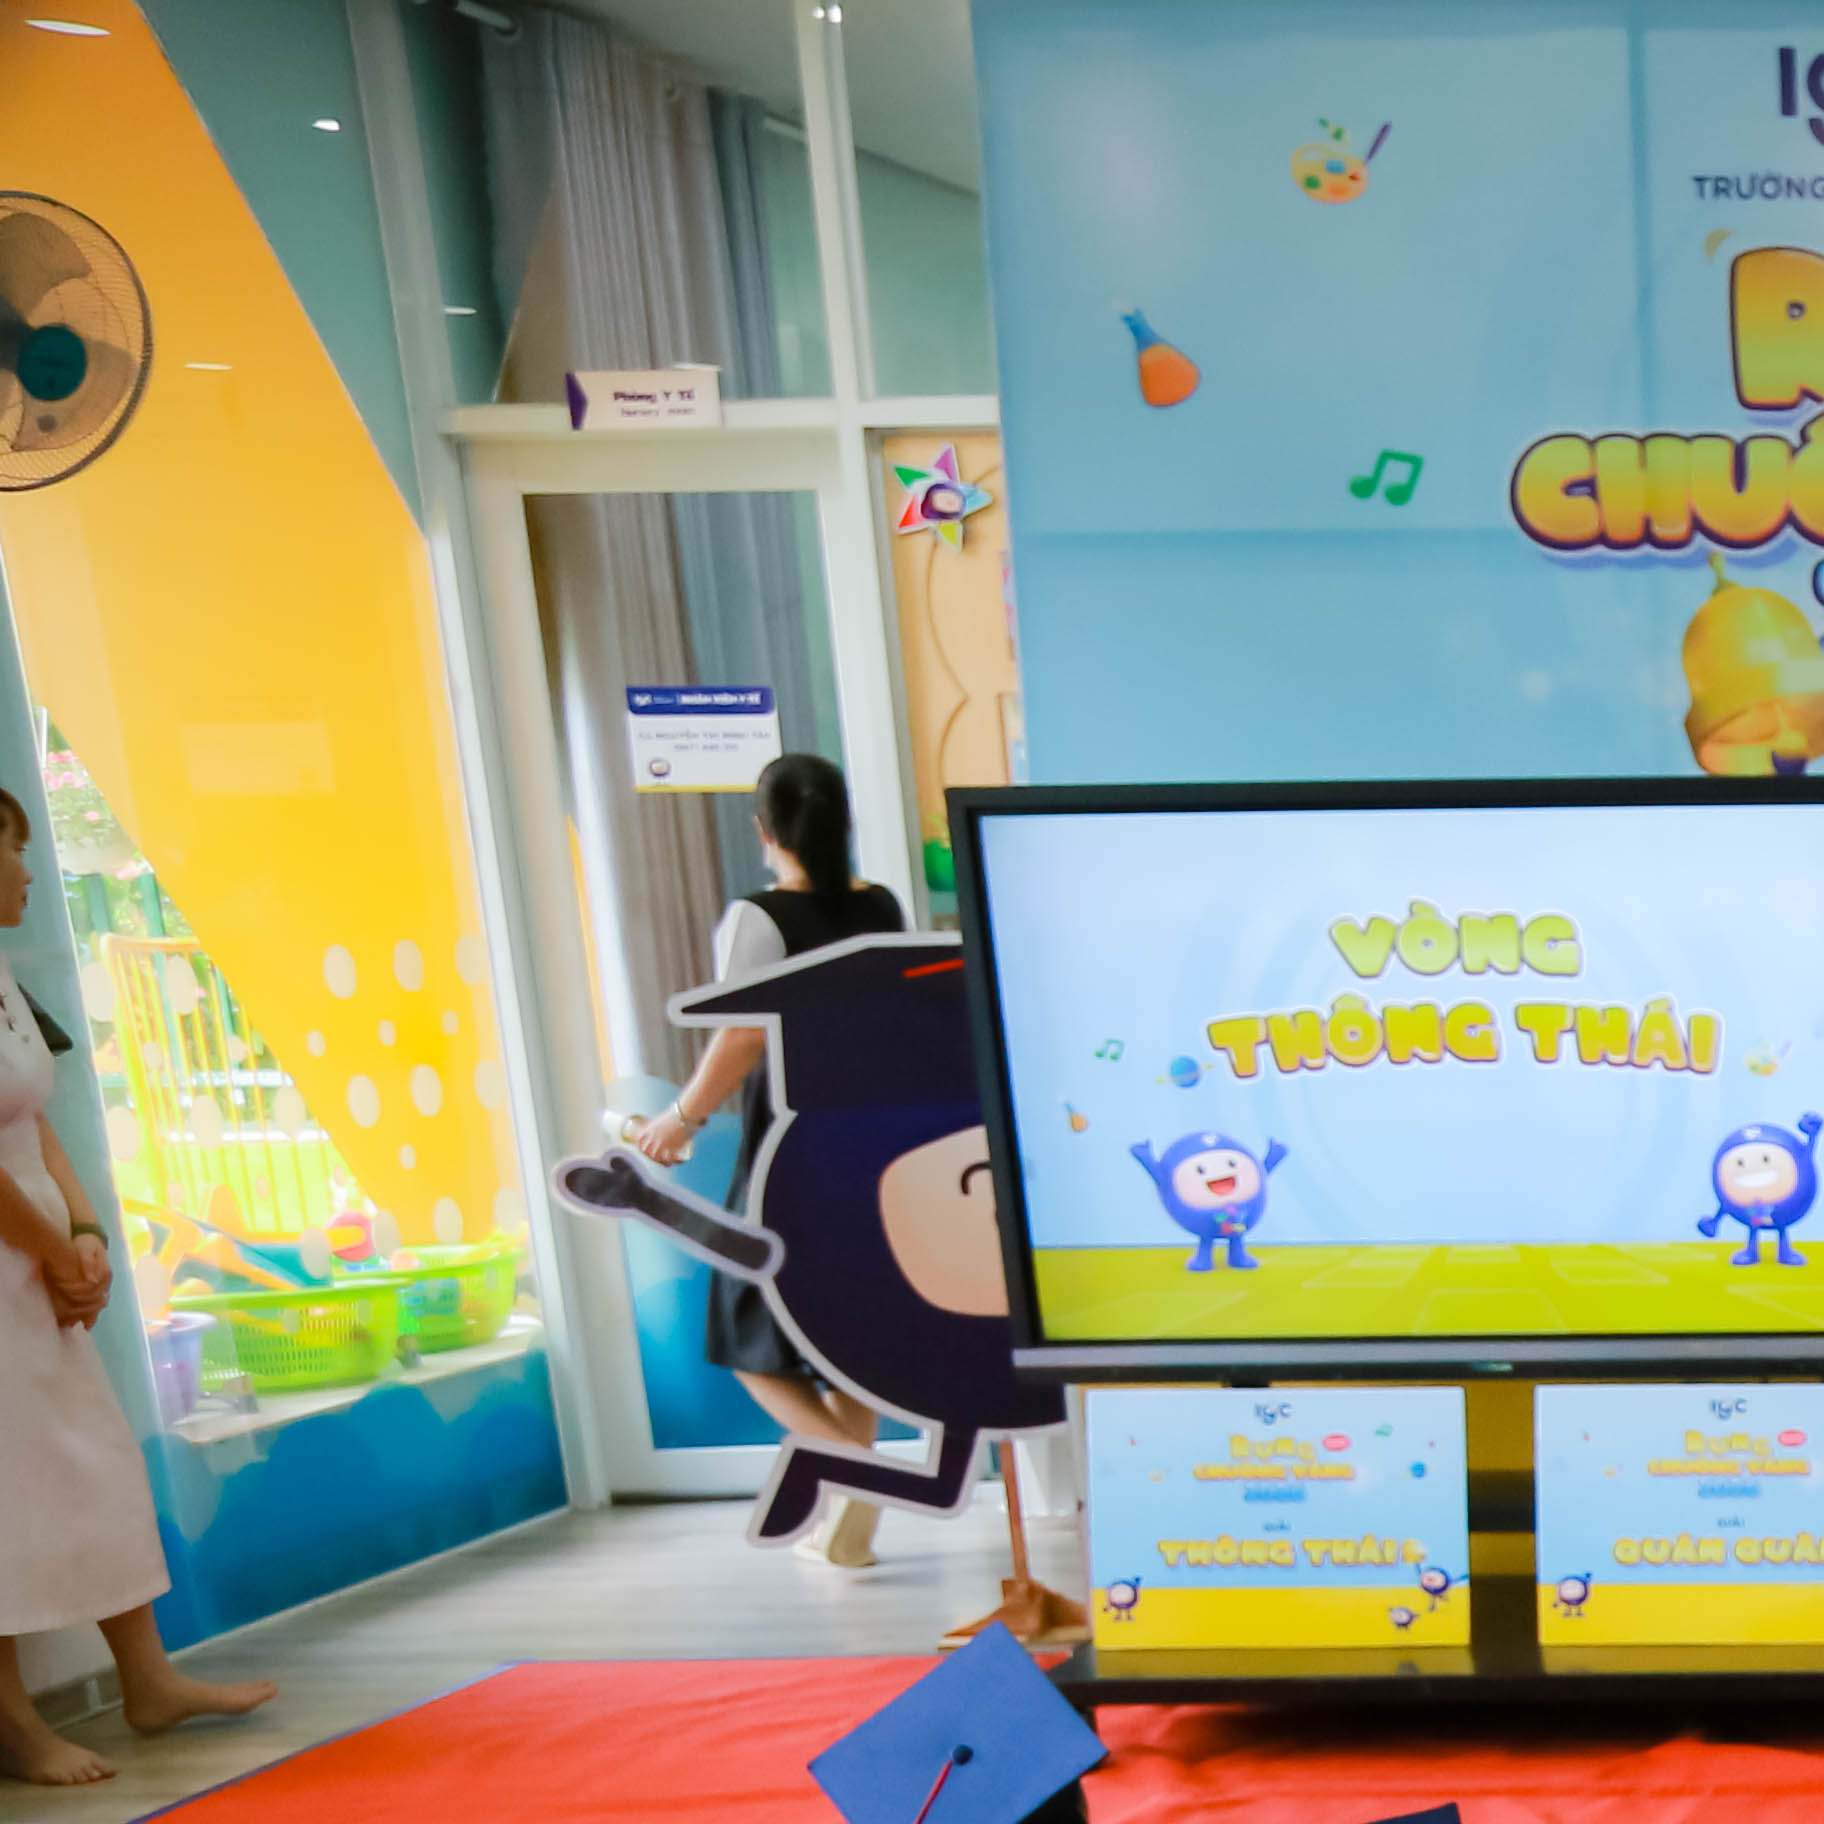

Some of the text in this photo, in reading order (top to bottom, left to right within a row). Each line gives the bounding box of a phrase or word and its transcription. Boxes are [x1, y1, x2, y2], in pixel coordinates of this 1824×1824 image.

[1329, 899, 1582, 978] VÒNG
[1207, 994, 1720, 1080] THÔNG THÁI
